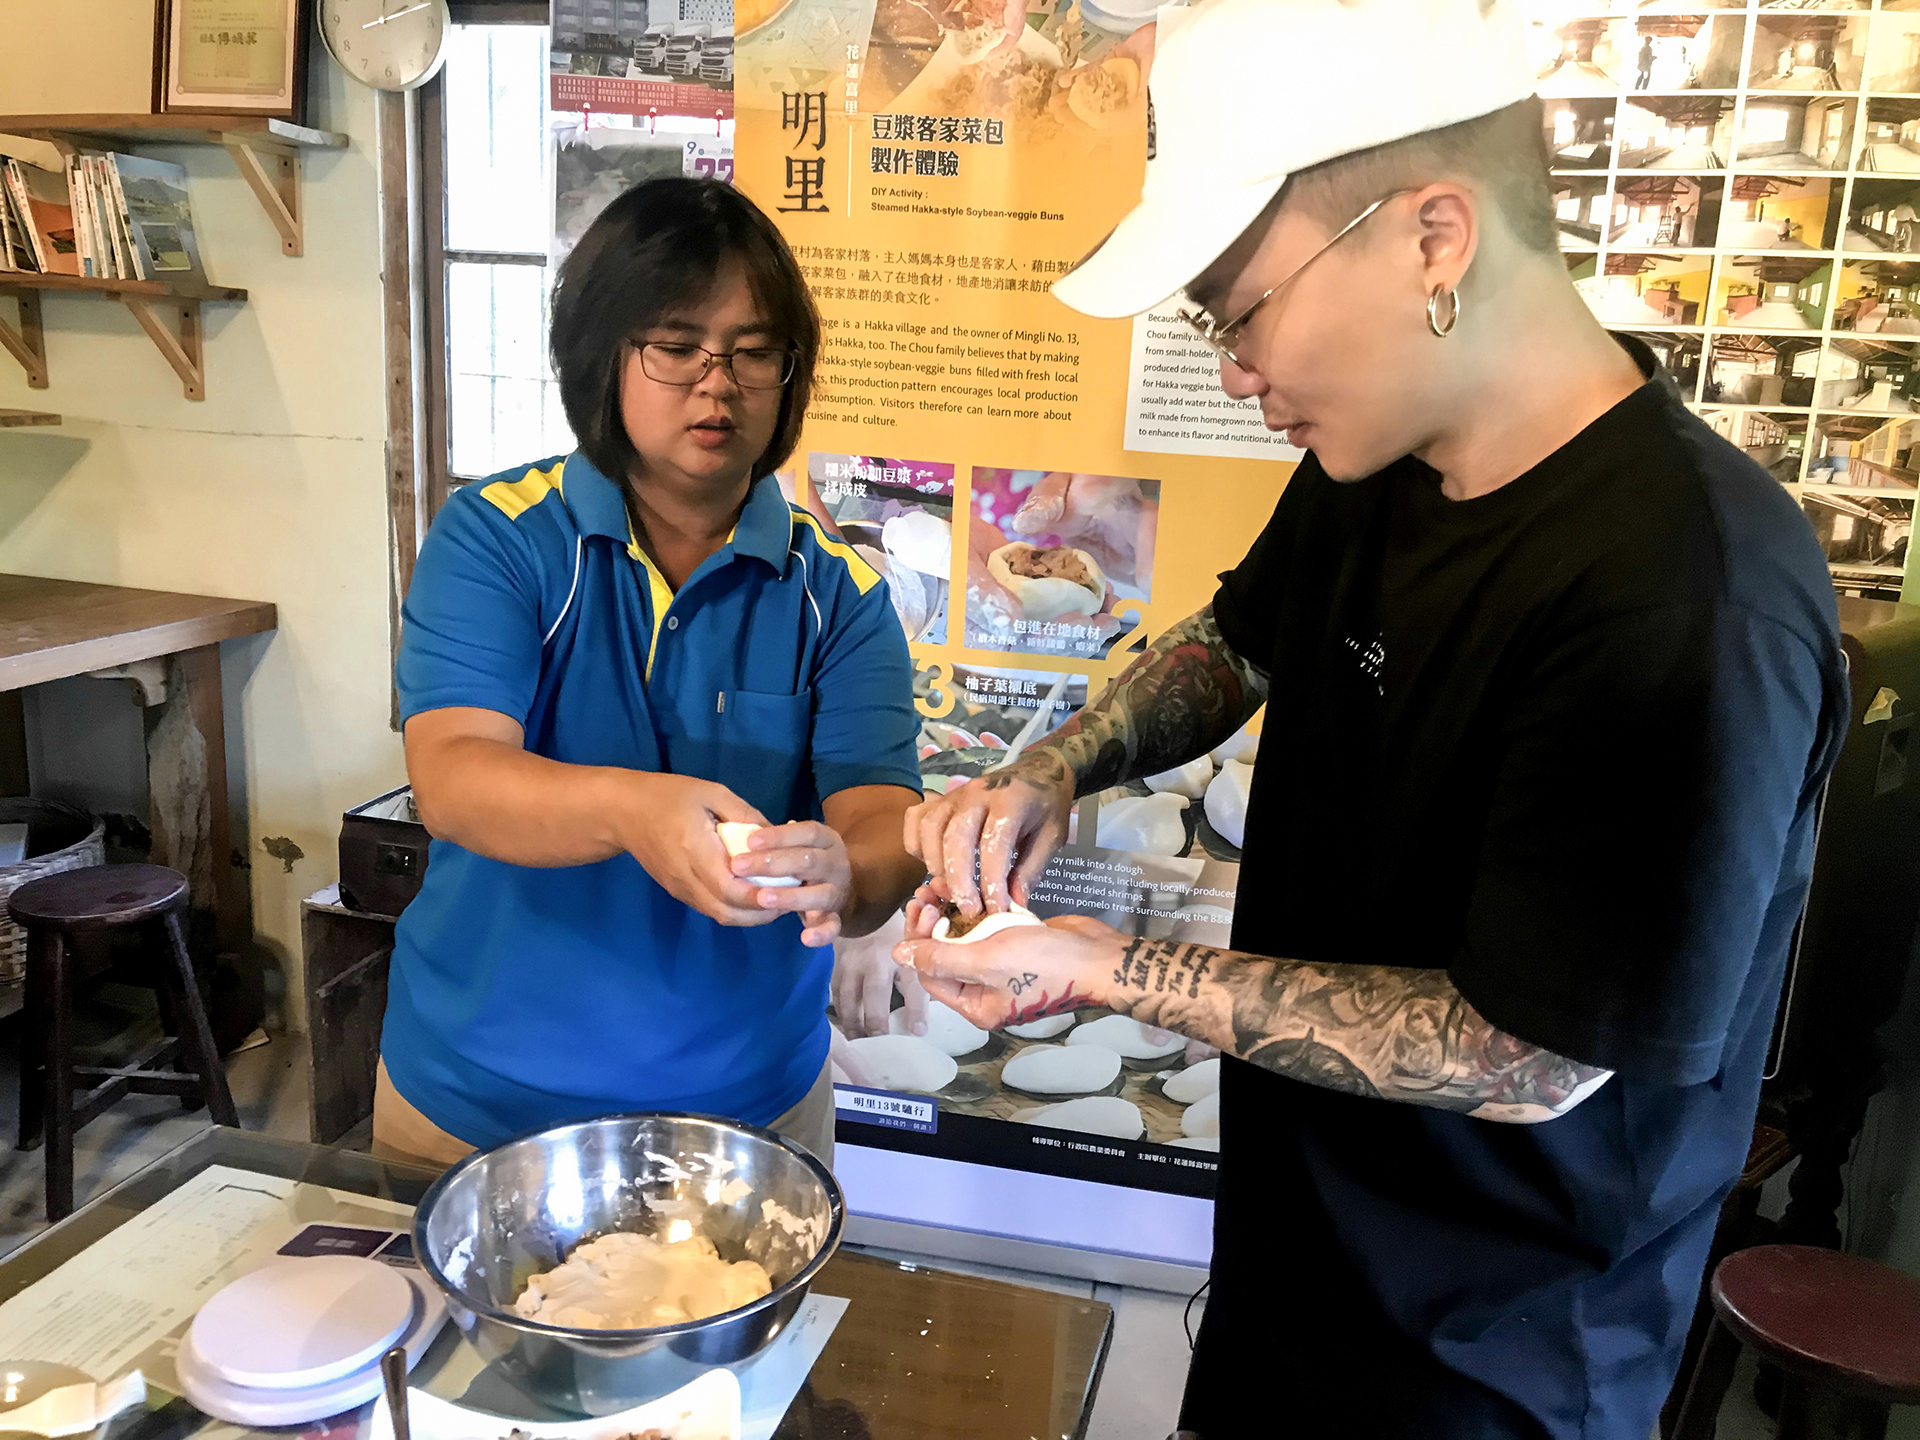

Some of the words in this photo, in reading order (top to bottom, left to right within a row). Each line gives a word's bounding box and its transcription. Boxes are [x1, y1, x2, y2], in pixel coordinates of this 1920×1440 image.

[334, 15, 340, 26] 9
[427, 16, 434, 28] 3
[343, 40, 350, 52] 8
[421, 42, 428, 53] 4
[361, 58, 368, 70] 7
[384, 66, 392, 78] 6
[408, 59, 414, 70] 5
[845, 44, 860, 116] 花蓮富里
[870, 113, 1004, 145] 豆漿客家菜包
[687, 141, 697, 154] 9
[776, 90, 830, 214] 明里
[870, 146, 960, 177] 製作體驗
[870, 187, 886, 196] DIY
[889, 188, 922, 200] Activity
[870, 202, 909, 212] Steamed
[911, 205, 964, 217] Hakka-style
[966, 207, 1038, 221] Soybean-veggie
[1040, 211, 1064, 221] Buns
[1148, 314, 1178, 323] Because
[842, 318, 850, 328] is
[864, 320, 892, 331] Hakka
[895, 322, 926, 336] village
[930, 325, 948, 335] and
[952, 326, 968, 337] the
[970, 330, 999, 339] owner
[1002, 329, 1012, 340] of
[1014, 331, 1045, 344] Mingli
[1047, 332, 1064, 343] No.
[1067, 333, 1080, 345] 13,
[1146, 330, 1166, 339] Chou
[1168, 331, 1192, 342] family
[835, 337, 866, 350] Hakka,
[868, 341, 886, 350] too.
[890, 341, 906, 352] The
[908, 342, 933, 353] Chou
[936, 344, 965, 358] family
[967, 346, 1004, 359] believes
[1006, 349, 1026, 360] that
[1030, 350, 1040, 363] by
[1043, 352, 1080, 366] making
[1145, 346, 1163, 355] from
[1165, 349, 1212, 358] small-holder
[818, 355, 871, 369] Hakka-style
[873, 360, 944, 375] soybean-veggie
[950, 364, 971, 376] buns
[976, 366, 998, 378] filled
[1001, 369, 1022, 379] with
[1026, 369, 1050, 381] fresh
[1054, 371, 1078, 383] local
[1143, 364, 1178, 373] produced
[1180, 365, 1199, 374] dried
[1201, 367, 1212, 377] log
[830, 374, 846, 385] this
[848, 377, 898, 389] production
[901, 382, 936, 392] pattern
[940, 385, 992, 398] encourages
[997, 387, 1020, 398] local
[1025, 390, 1078, 402] production
[1142, 379, 1153, 387] for
[1155, 380, 1178, 389] Hakka
[1180, 383, 1204, 392] veggie
[880, 397, 914, 409] Visitors
[919, 400, 962, 413] therefore
[966, 406, 982, 414] can
[987, 406, 1011, 417] learn
[1013, 410, 1038, 419] more
[1043, 409, 1072, 421] about
[1141, 397, 1167, 406] usually
[1168, 398, 1182, 406] add
[1208, 400, 1220, 408] but
[1222, 399, 1235, 409] the
[1236, 399, 1256, 410] Chou
[806, 411, 838, 421] cuisine
[841, 414, 858, 423] and
[862, 415, 897, 426] culture.
[1140, 412, 1155, 420] milk
[1157, 414, 1178, 422] made
[1180, 414, 1198, 422] from
[1200, 415, 1245, 426] homegrown
[1148, 429, 1179, 438] enhance
[1191, 431, 1213, 440] flavor
[1214, 433, 1229, 441] and
[1230, 434, 1270, 443] nutritional
[824, 480, 867, 498] 揉成皮
[1013, 620, 1102, 640] 包進在地食材
[914, 662, 956, 718] 3
[965, 676, 1037, 696] 柚子葉襯底
[1052, 857, 1064, 865] oy
[1065, 858, 1084, 866] milk
[1086, 859, 1104, 869] into
[1114, 863, 1144, 875] dough.
[1038, 880, 1062, 890] aikon
[1064, 884, 1080, 892] and
[1082, 885, 1105, 896] dried
[1107, 890, 1145, 902] shrimps.
[1062, 869, 1114, 885] ingredients,
[1116, 877, 1158, 892] including
[1160, 882, 1235, 898] locally-produced
[1052, 894, 1074, 904] from
[1076, 899, 1110, 909] pomelo
[1112, 904, 1134, 914] trees
[1136, 906, 1190, 922] surrounding
[1193, 911, 1208, 922] the
